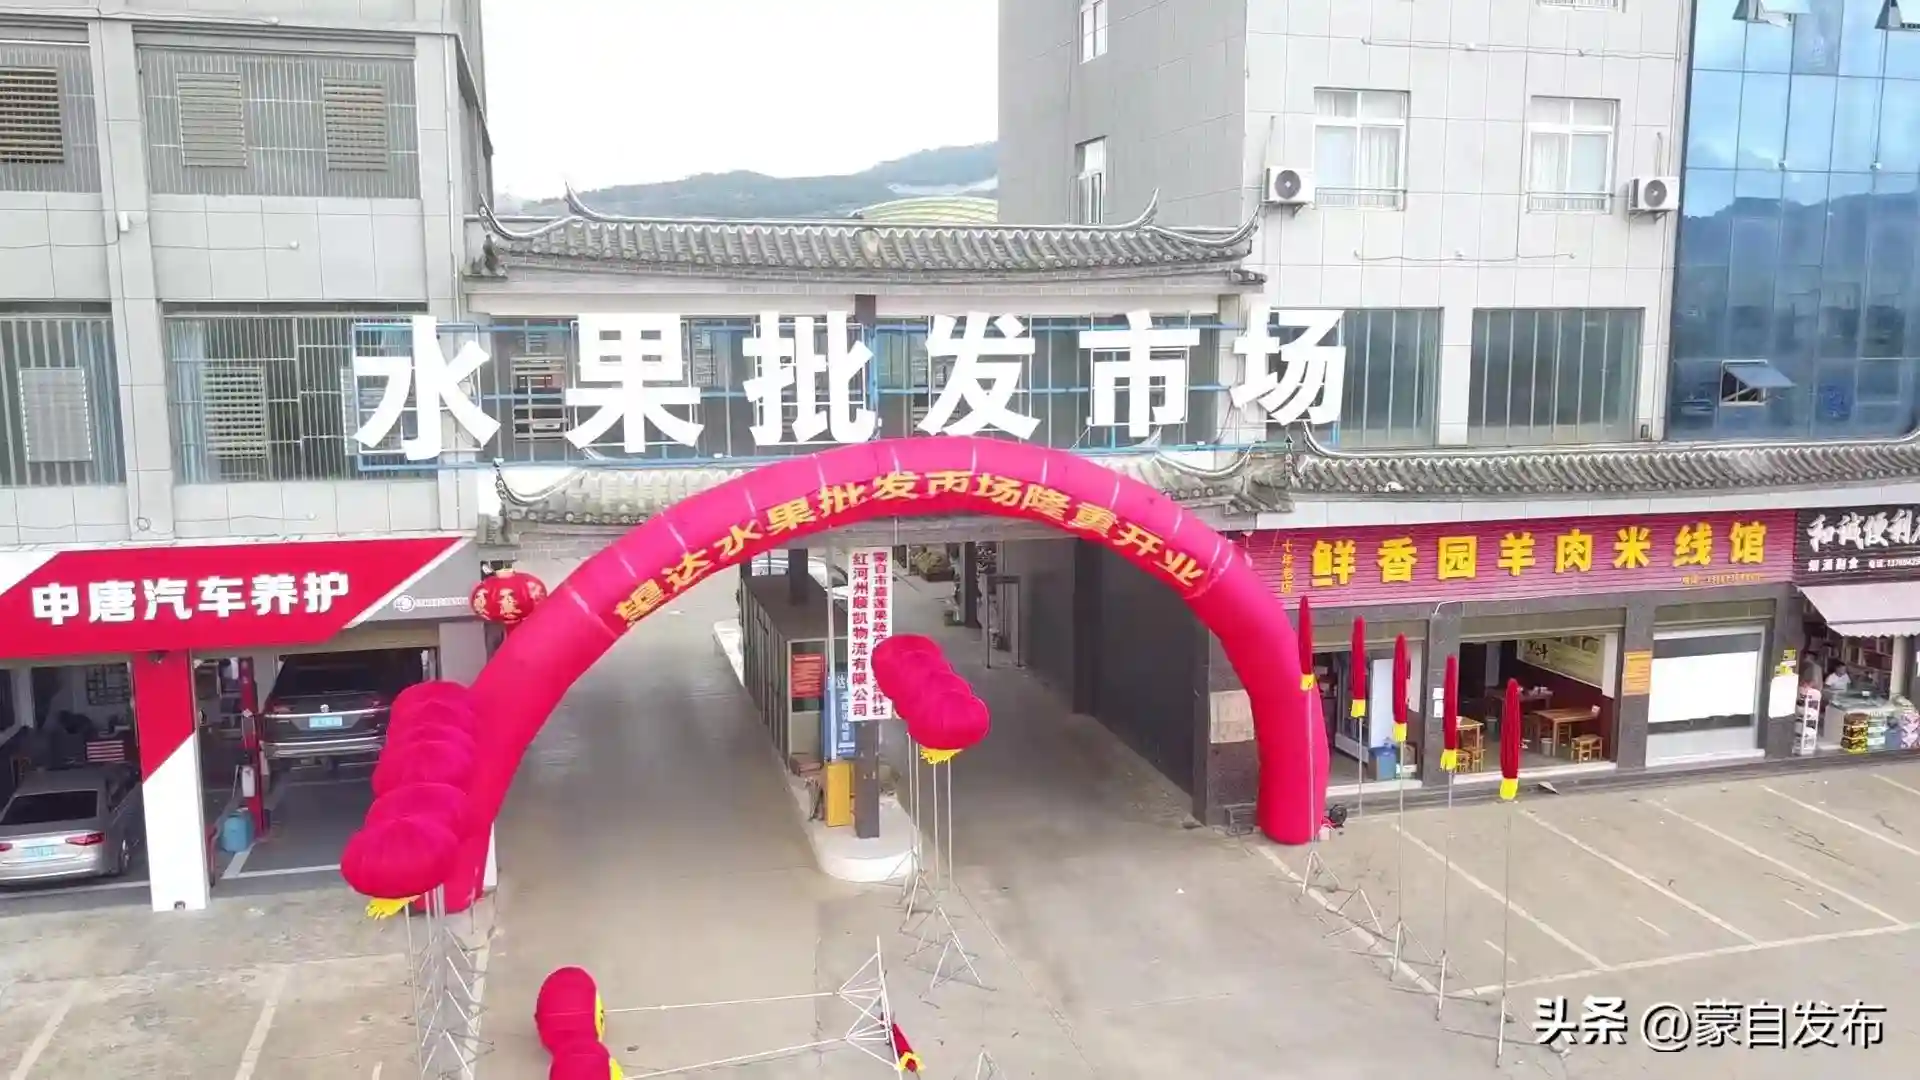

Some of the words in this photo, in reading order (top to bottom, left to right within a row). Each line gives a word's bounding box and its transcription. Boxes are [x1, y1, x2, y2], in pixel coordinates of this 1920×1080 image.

[351, 310, 1346, 461] 水果批发市场
[31, 572, 349, 625] 申唐汽车养护
[613, 470, 1206, 627] 望达水果批发市场隆重开业
[1311, 521, 1767, 587] 鲜香园羊肉米线馆
[852, 552, 869, 717] 红河州顺凯物流有限公司
